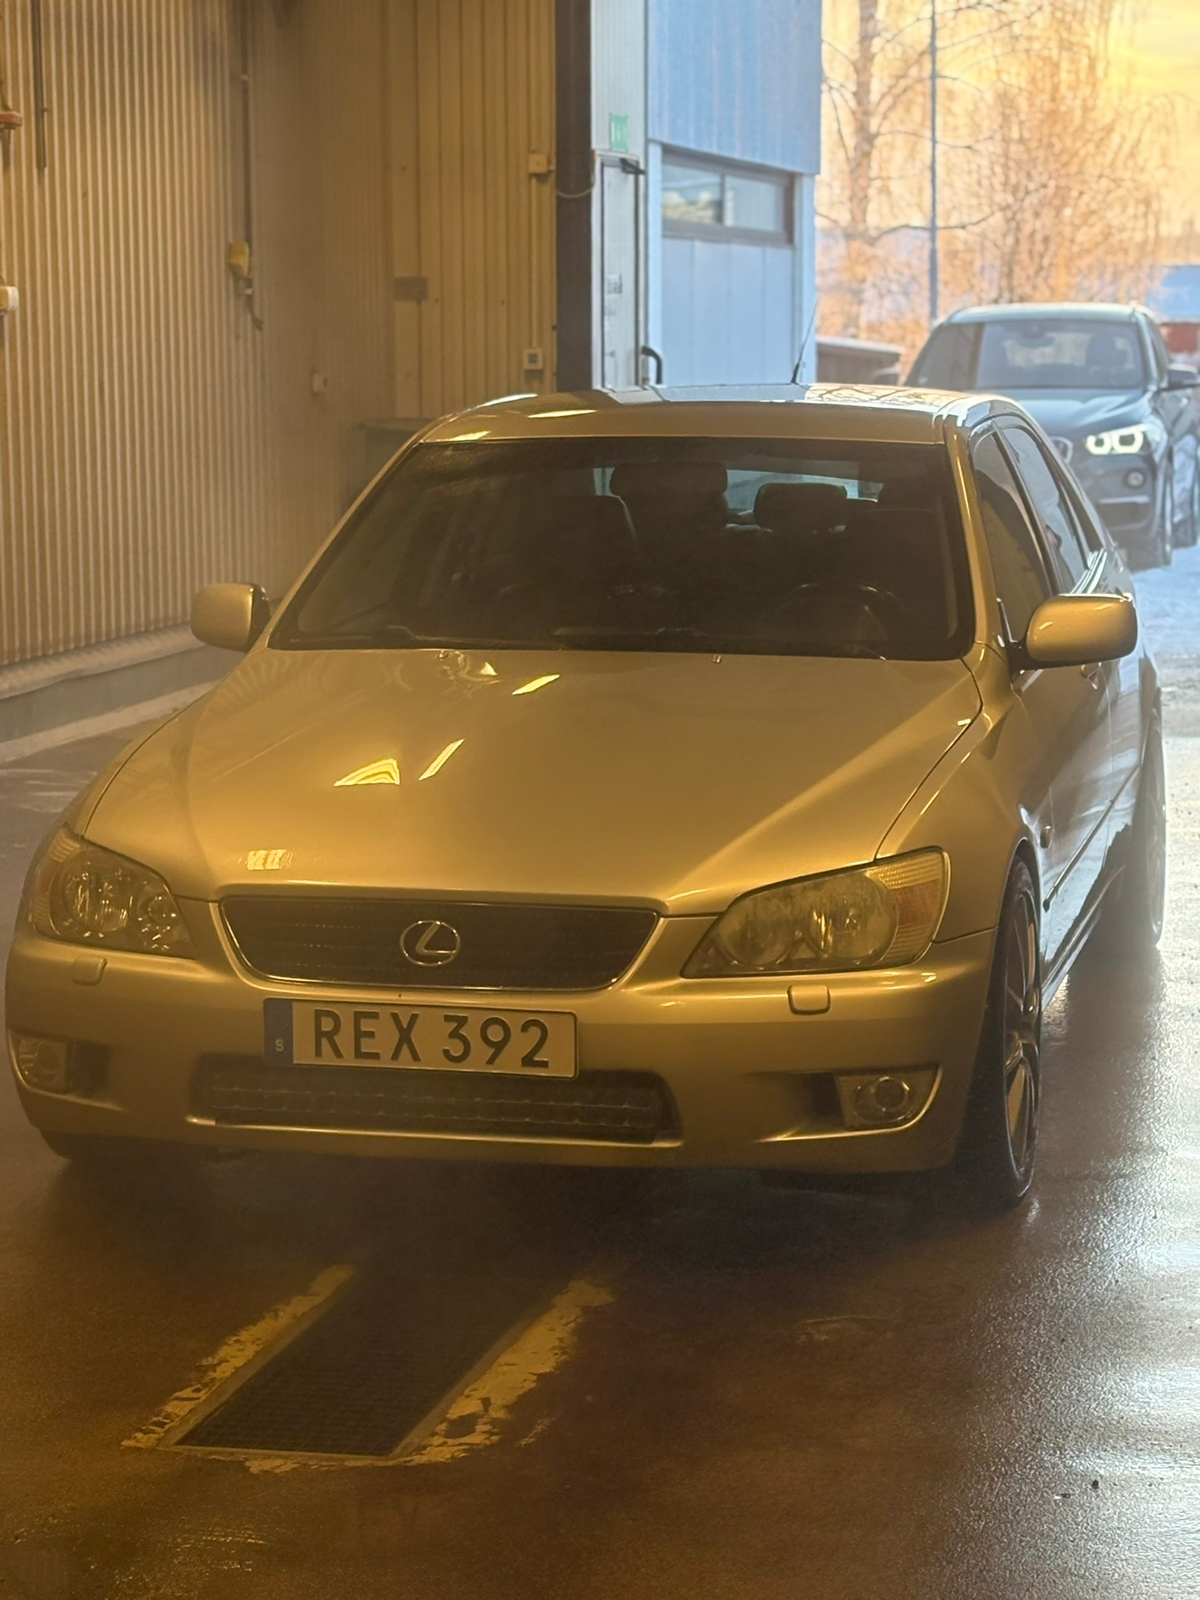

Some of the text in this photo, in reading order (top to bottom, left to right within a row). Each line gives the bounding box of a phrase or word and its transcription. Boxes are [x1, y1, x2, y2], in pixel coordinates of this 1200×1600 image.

[275, 1038, 285, 1052] S
[314, 1009, 549, 1068] REX 392
